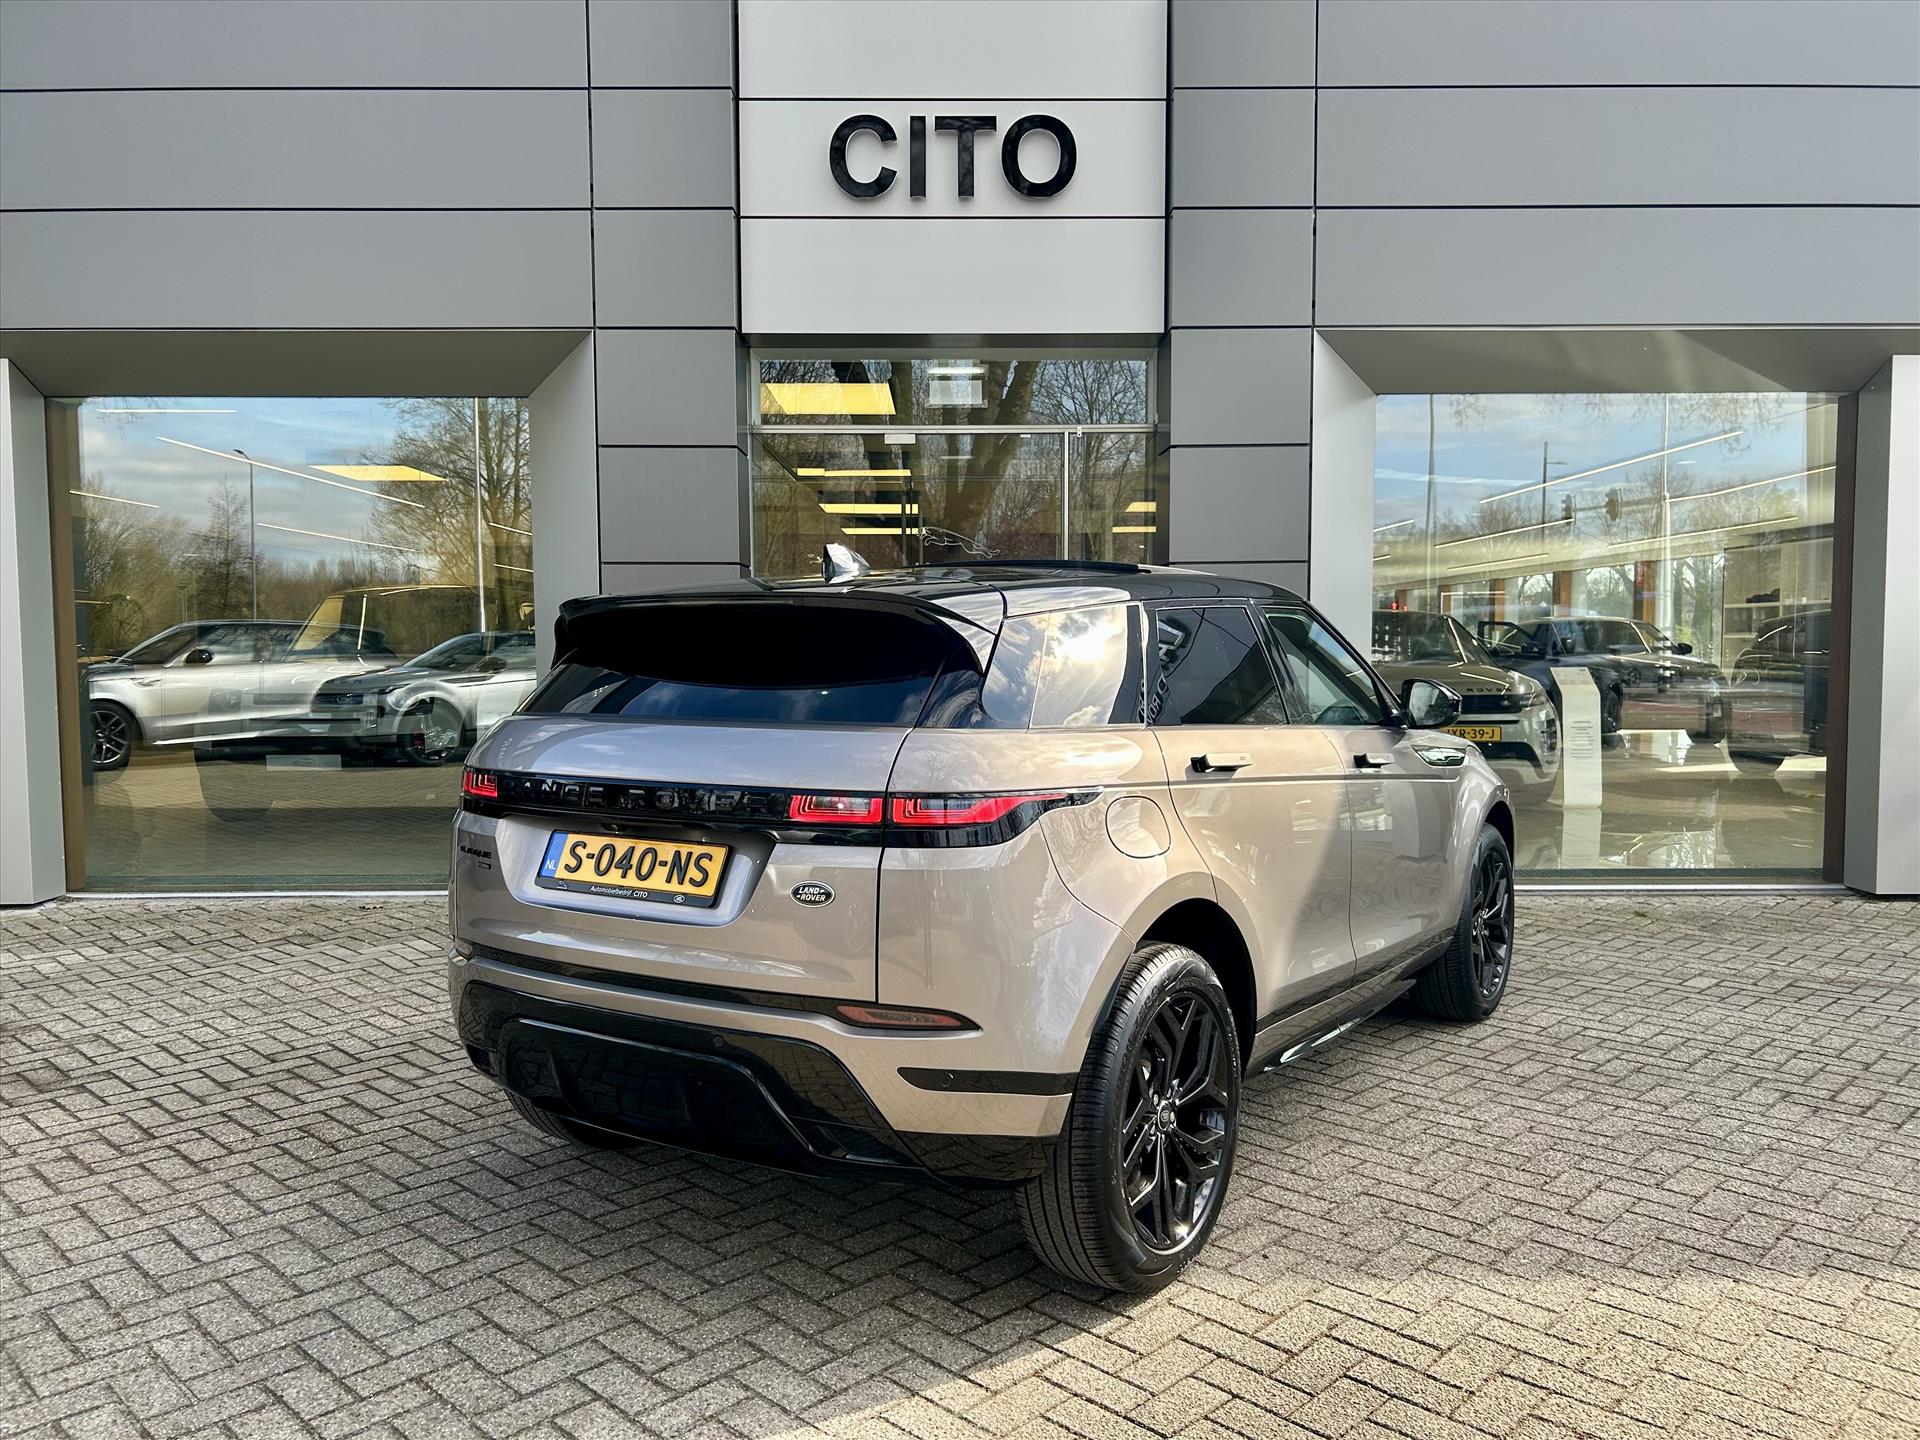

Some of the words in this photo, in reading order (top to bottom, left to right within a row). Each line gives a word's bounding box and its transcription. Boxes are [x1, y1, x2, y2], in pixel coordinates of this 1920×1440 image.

[829, 114, 1077, 198] CITO
[1446, 728, 1495, 739] XR-39-J
[544, 860, 556, 870] NL
[564, 840, 713, 887] S-040-NS
[633, 890, 648, 899] CITO
